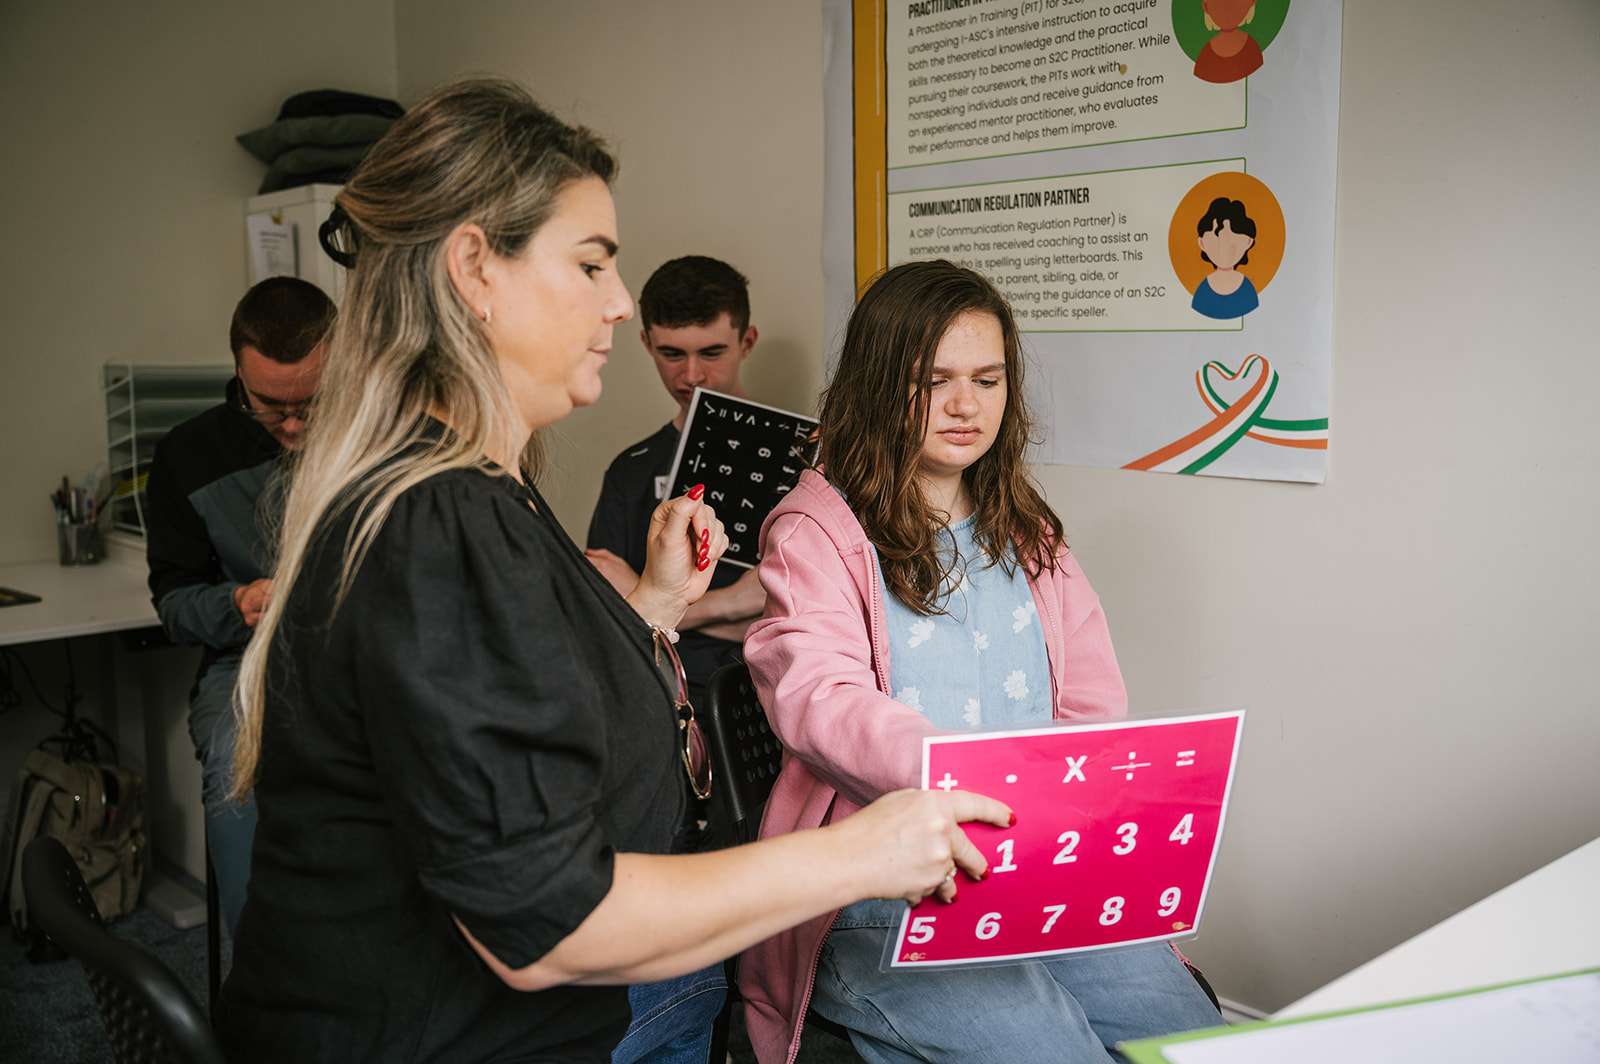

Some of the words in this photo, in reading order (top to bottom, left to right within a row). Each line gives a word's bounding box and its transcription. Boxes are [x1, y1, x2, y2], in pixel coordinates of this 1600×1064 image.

[908, 28, 914, 37] A
[916, 18, 967, 36] Practitioner
[969, 15, 978, 24] in
[980, 8, 1018, 22] Training
[1020, 1, 1043, 16] (PIT)
[908, 36, 959, 54] undergoing
[996, 21, 1040, 36] intensive
[1042, 10, 1096, 28] instruction
[1100, 7, 1111, 16] to
[1113, 0, 1157, 14] acquire
[908, 60, 929, 71] both
[930, 57, 946, 66] the
[947, 46, 997, 62] theoretical
[1000, 37, 1052, 54] knowledge
[1055, 31, 1076, 44] and
[1078, 28, 1096, 40] the
[1098, 17, 1148, 39] practical
[908, 76, 928, 88] skills
[930, 69, 978, 84] necessary
[978, 66, 989, 76] to
[990, 59, 1031, 74] become
[1033, 56, 1047, 66] an
[1049, 51, 1069, 64] S2C
[1071, 40, 1136, 60] Practitioner.
[1138, 34, 1170, 49] While
[908, 91, 947, 108] pursuing
[948, 86, 970, 98] their
[1030, 74, 1047, 86] the
[1049, 70, 1068, 82] PITs
[1070, 65, 1096, 78] work
[1098, 60, 1121, 74] with
[908, 105, 966, 121] nonspeaking
[967, 96, 1018, 112] individuals
[1020, 92, 1040, 104] and
[1042, 87, 1080, 101] receive
[1082, 79, 1134, 98] guidance
[1136, 75, 1164, 87] from
[908, 129, 920, 138] an
[922, 118, 977, 138] experienced
[979, 114, 1014, 128] mentor
[1016, 106, 1076, 126] practitioner,
[1078, 101, 1101, 114] who
[1104, 95, 1158, 110] evaluates
[908, 143, 928, 154] their
[930, 136, 989, 155] performance
[991, 131, 1010, 144] and
[1013, 128, 1040, 142] helps
[1042, 125, 1068, 138] them
[1071, 120, 1118, 136] improve.
[909, 197, 982, 218] COMMUNICATION
[984, 192, 1041, 211] REGULATION
[1044, 188, 1090, 206] PARTNER
[910, 230, 916, 239] A
[917, 228, 935, 238] CRP
[936, 222, 1015, 240] (Communication
[1017, 218, 1071, 234] Regulation
[1073, 211, 1116, 228] Partner)
[1118, 213, 1128, 224] is
[910, 245, 950, 256] someone
[952, 242, 972, 252] who
[974, 242, 991, 250] has
[993, 238, 1034, 250] received
[1036, 235, 1085, 249] coaching
[1088, 235, 1098, 245] to
[1100, 232, 1131, 244] assist
[1134, 232, 1148, 242] an
[975, 259, 982, 268] is
[984, 256, 1021, 270] spelling
[1024, 254, 1050, 268] using
[1053, 250, 1120, 264] letterboards.
[1122, 250, 1144, 261] This
[996, 276, 1004, 284] a
[1006, 274, 1040, 286] parent,
[1042, 272, 1077, 286] sibling,
[1080, 270, 1106, 282] aide,
[1108, 271, 1119, 280] or
[1042, 290, 1060, 300] the
[1062, 288, 1112, 303] guidance
[1114, 287, 1124, 299] of
[1126, 288, 1142, 298] an
[1144, 286, 1166, 298] S2C
[1030, 308, 1069, 320] specific
[1072, 306, 1108, 320] speller.
[758, 447, 772, 458] 9
[710, 490, 724, 502] 2
[719, 464, 732, 476] 3
[728, 439, 740, 450] 4
[750, 472, 764, 483] 8
[740, 498, 754, 510] 7
[734, 522, 748, 533] 6
[992, 838, 1018, 874] 1
[1052, 830, 1081, 866] 2
[1112, 822, 1139, 856] 3
[1168, 812, 1194, 846] 4
[907, 916, 937, 945] 5
[974, 912, 1002, 940] 6
[1041, 904, 1067, 934] 7
[1098, 896, 1126, 926] 8
[1157, 886, 1182, 918] 9
